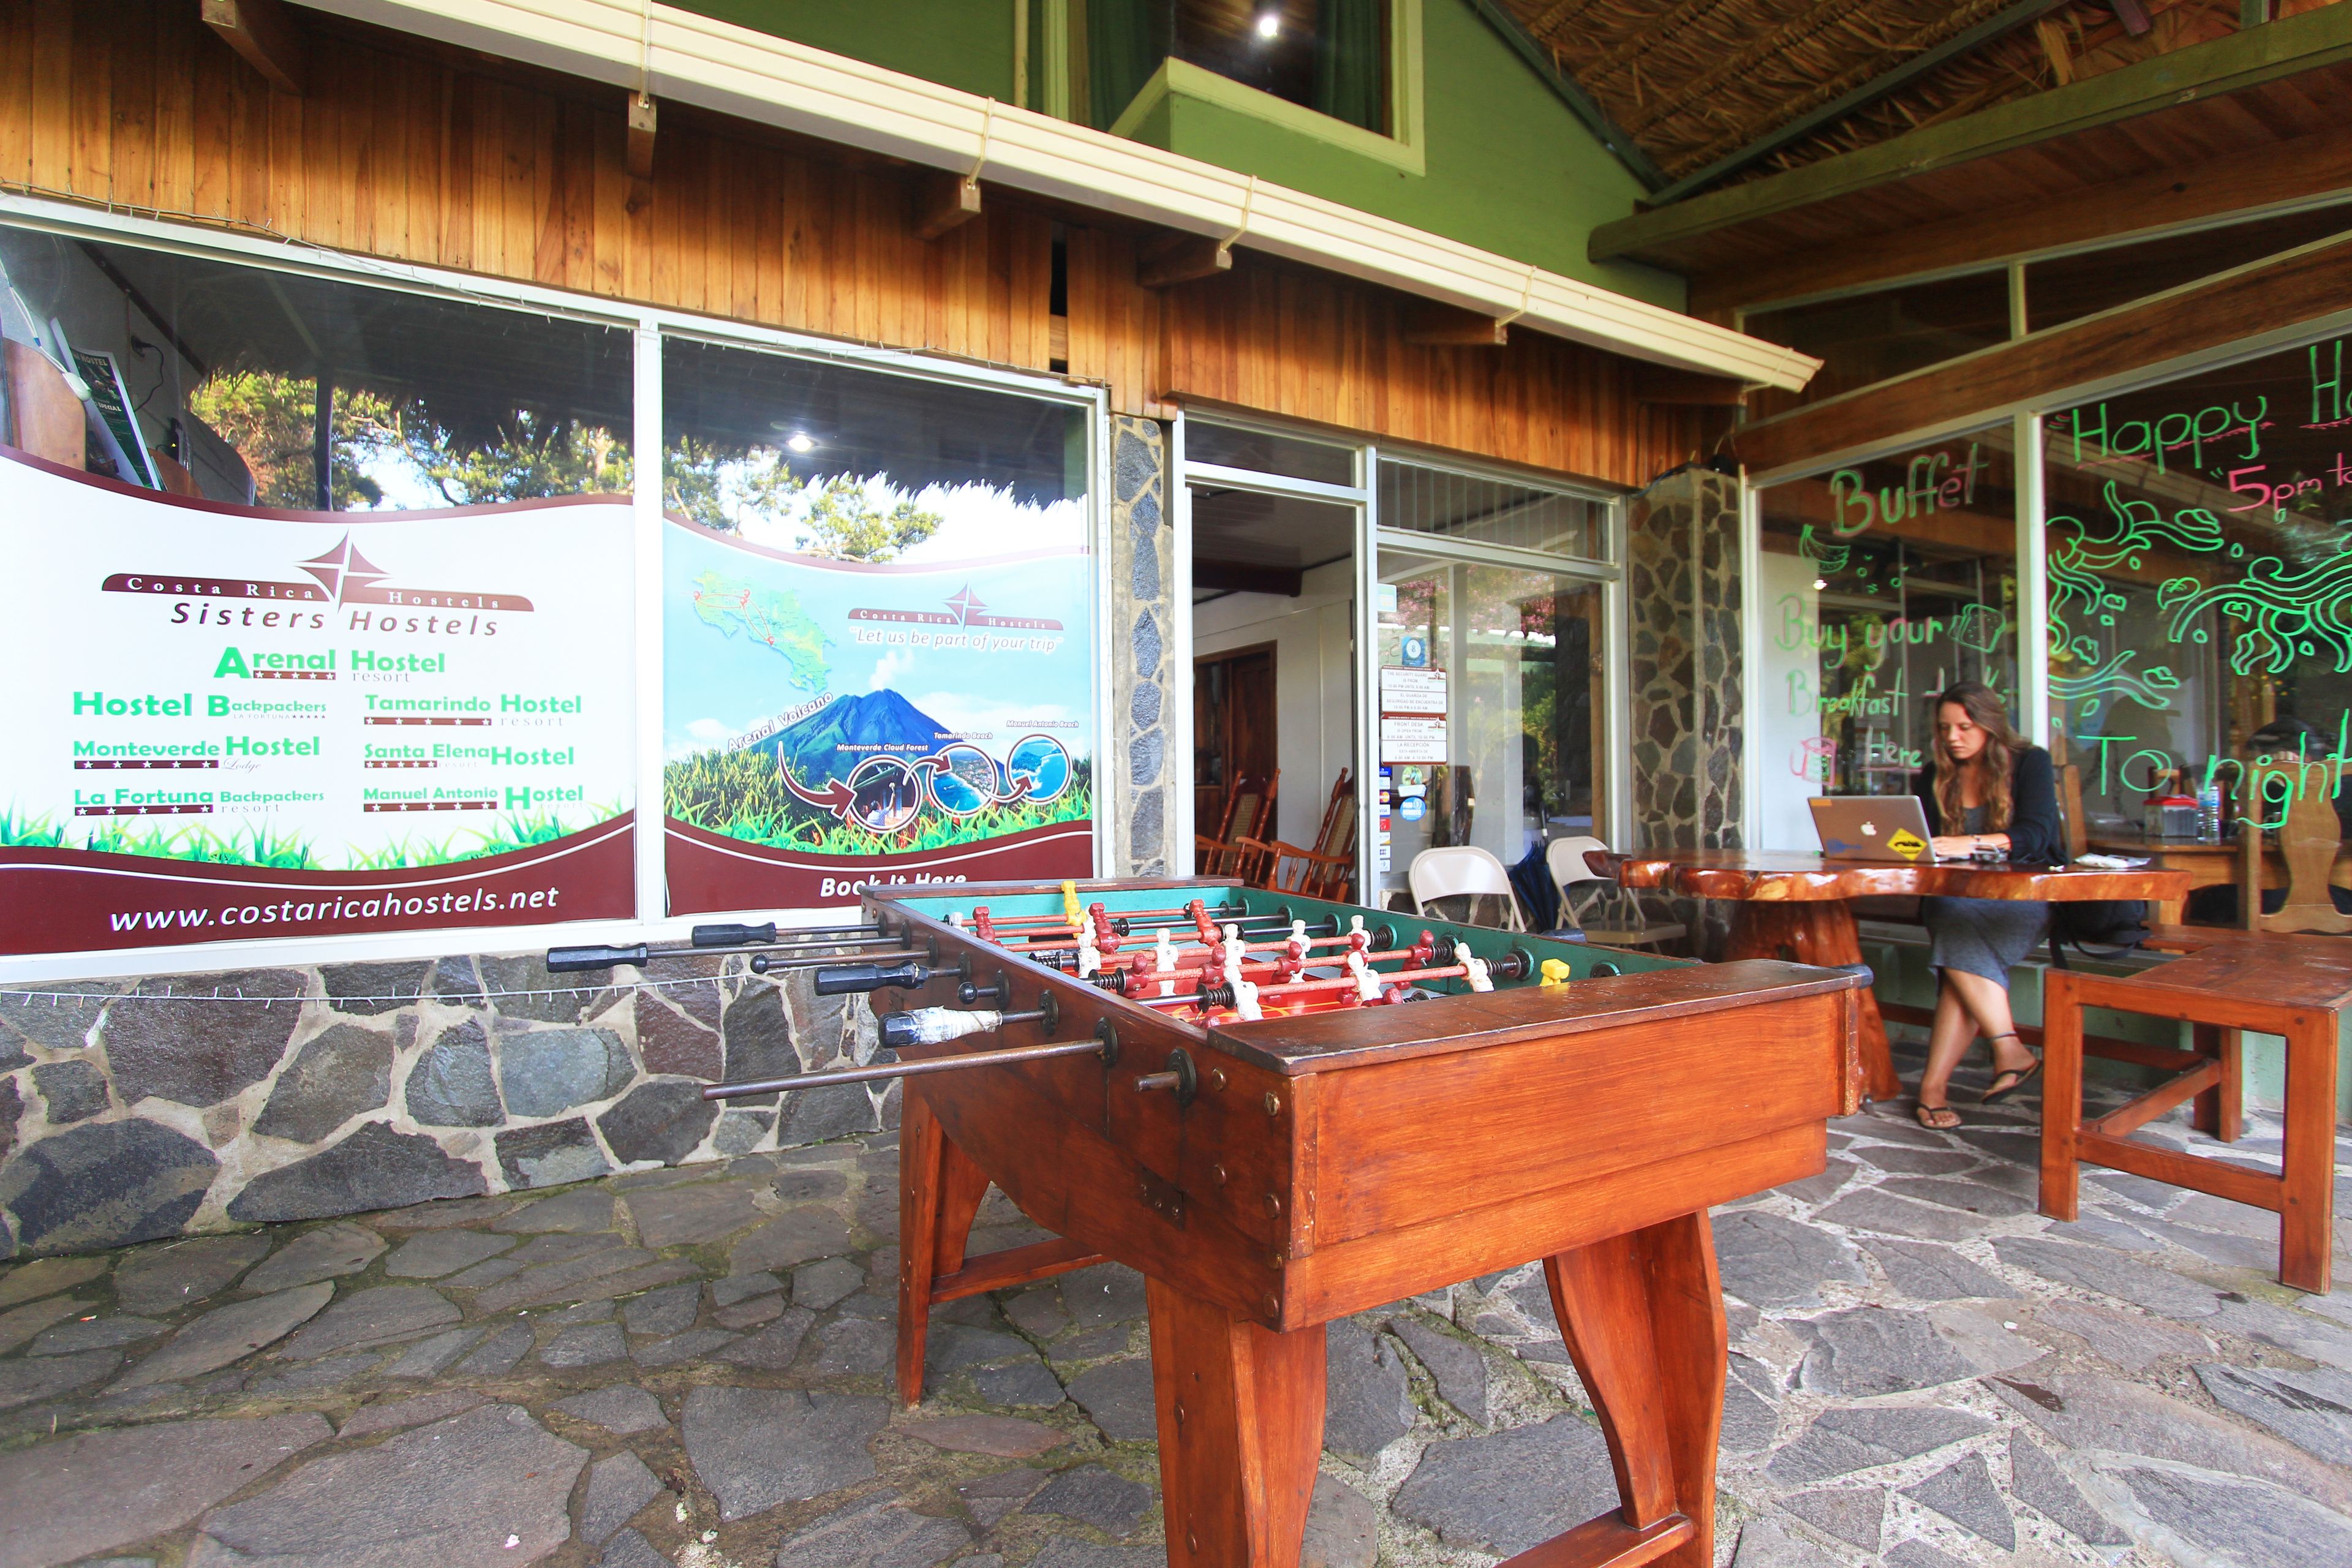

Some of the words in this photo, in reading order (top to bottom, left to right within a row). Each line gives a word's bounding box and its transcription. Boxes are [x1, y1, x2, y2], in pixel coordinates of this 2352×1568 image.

[2309, 340, 2352, 424] H
[1830, 442, 1989, 537] Buffet
[127, 577, 221, 595] Costa
[246, 584, 313, 599] Rica
[388, 591, 499, 609] Hostels
[171, 602, 324, 629] Sisters
[349, 611, 497, 636] Hostels
[859, 610, 905, 621] Costa
[917, 613, 951, 624] Rica
[989, 617, 1046, 628] Hostels
[888, 633, 904, 643] us
[911, 631, 929, 644] be
[935, 634, 967, 647] part
[972, 634, 988, 650] of
[993, 636, 1024, 651] your
[1774, 593, 1850, 669] Buy
[1864, 617, 1943, 671] your
[214, 647, 336, 679] Arenal
[351, 650, 445, 673] Hostel
[352, 671, 410, 682] resort
[73, 691, 192, 717] Hostel
[208, 695, 326, 717] Backpackers
[365, 694, 491, 712] Tamarindo
[500, 694, 581, 714] Hostel
[1786, 666, 1909, 719] Breakfast
[501, 716, 564, 727] resort
[728, 719, 775, 753] Arenal
[777, 692, 834, 727] Volcano
[74, 741, 220, 757] Monteverde
[226, 736, 320, 756] Hostel
[364, 744, 425, 758] Santa
[432, 744, 490, 758] Elena
[491, 746, 574, 766] Hostel
[836, 744, 882, 753] Monteverde
[883, 744, 905, 752] Cloud
[906, 744, 929, 752] Forest
[1867, 725, 1923, 767] Here
[221, 758, 262, 774] Lodge
[75, 789, 106, 805] La
[115, 788, 214, 804] Fortuna
[221, 791, 325, 804] Backpackers
[221, 804, 280, 813] resort
[364, 788, 428, 800] Manuel
[432, 787, 499, 799] Antonio
[505, 785, 583, 810] Hostel
[820, 874, 881, 897] Book
[110, 886, 560, 931] www.costaricahostels.net
